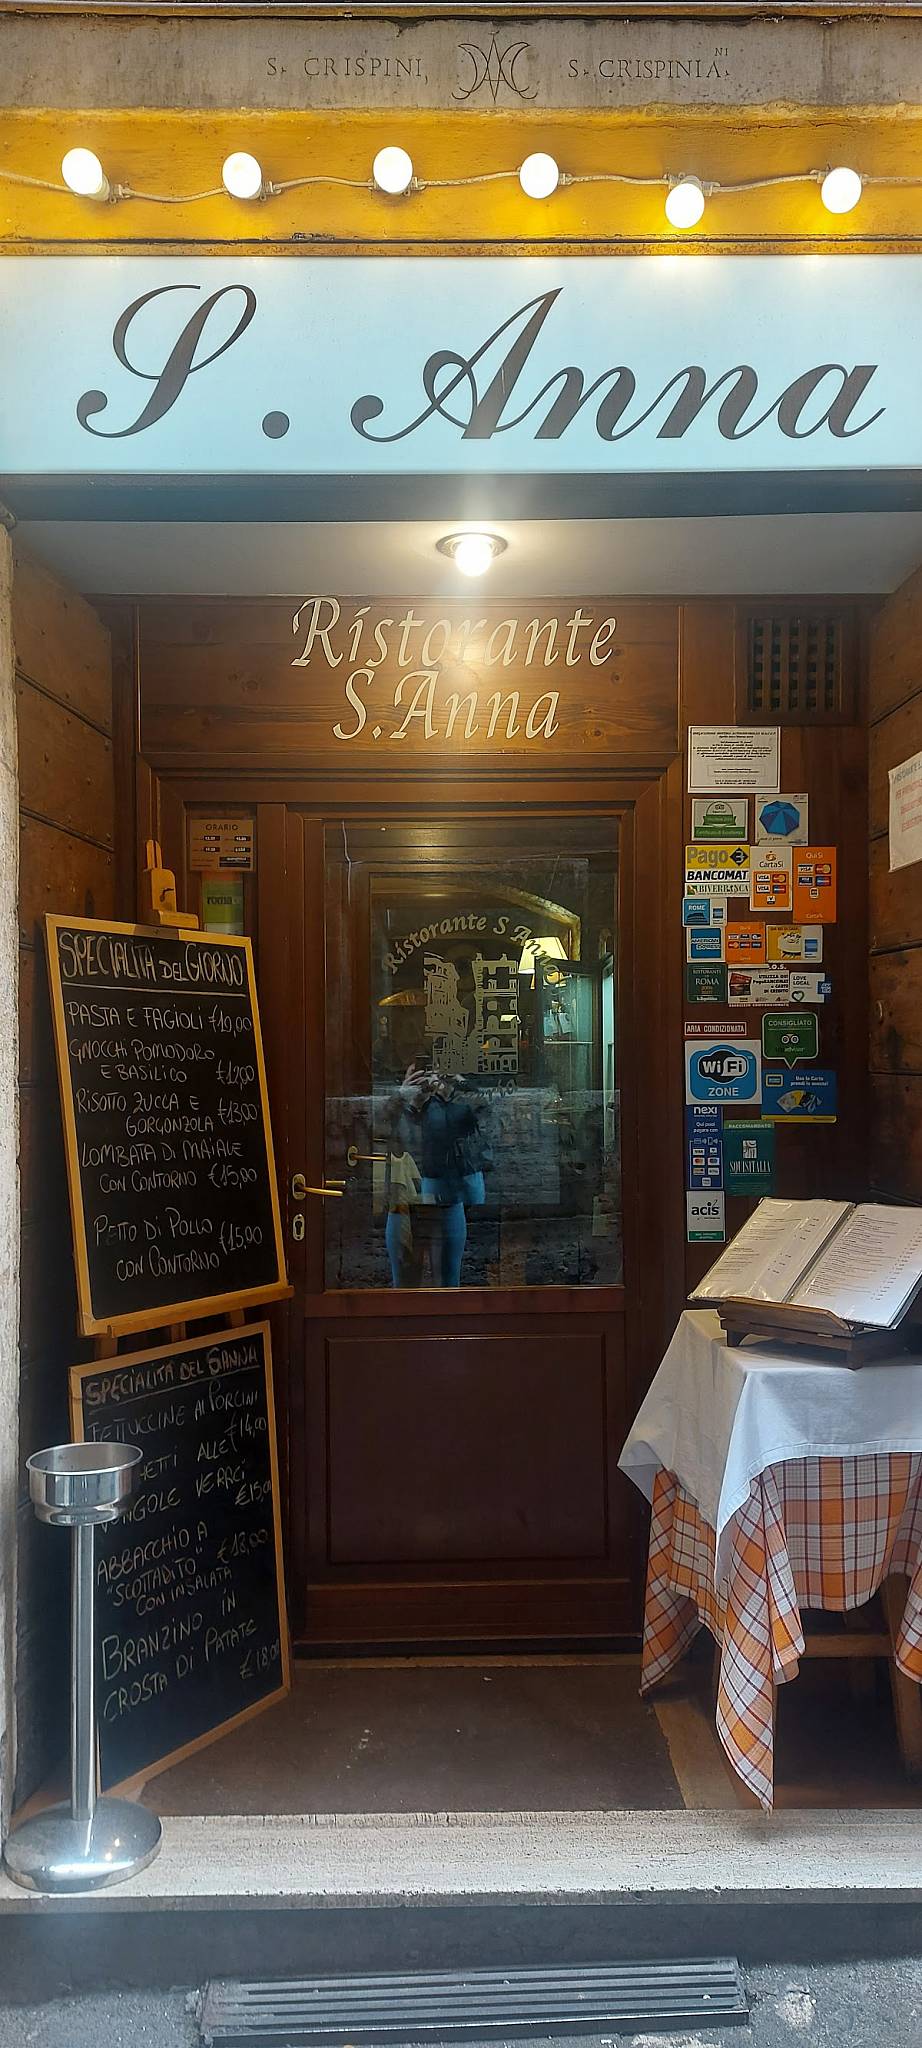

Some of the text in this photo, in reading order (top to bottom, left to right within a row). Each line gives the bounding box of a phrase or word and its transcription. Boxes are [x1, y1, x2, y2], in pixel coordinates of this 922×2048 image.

[350, 286, 887, 442] Anna
[291, 597, 617, 669] Ristorante
[333, 667, 560, 739] S.Anna
[687, 847, 729, 865] Pago
[687, 870, 749, 881] BANCOMAT
[384, 912, 488, 975] Ristorante
[492, 916, 511, 935] S
[158, 960, 190, 981] DEL
[185, 942, 244, 987] GIORNO
[695, 977, 720, 985] ROMA
[65, 1001, 121, 1028] PASTA
[126, 1008, 138, 1028] E
[686, 1025, 746, 1033] ARIA CONDIZIONATA
[100, 1064, 111, 1079] E
[114, 1064, 188, 1083] BASILICO
[76, 1088, 127, 1113] RISOTTO
[132, 1090, 180, 1114] ZUCCA
[189, 1094, 200, 1111] E
[708, 1087, 740, 1097] ZONE
[693, 1106, 718, 1114] nexi
[125, 1114, 214, 1137] GORGONZOLA
[81, 1141, 157, 1168] LOMBATA
[729, 1160, 771, 1174] SQUISITALIA
[99, 1172, 126, 1194] CON
[131, 1169, 197, 1193] CONTORNO
[691, 1202, 720, 1216] acis
[164, 1206, 213, 1239] POLLO
[116, 1245, 220, 1282] CON CONTORNO
[179, 1359, 204, 1381] DEL
[87, 1405, 185, 1442] FETTUCCINE
[208, 1379, 259, 1412] PORCINI
[197, 1438, 230, 1463] ALLE
[97, 1520, 208, 1586] ABBACCHIO A
[135, 1565, 233, 1617] CON INSALATA
[102, 1612, 203, 1681] BRANZINO
[103, 1673, 169, 1723] CROSTA
